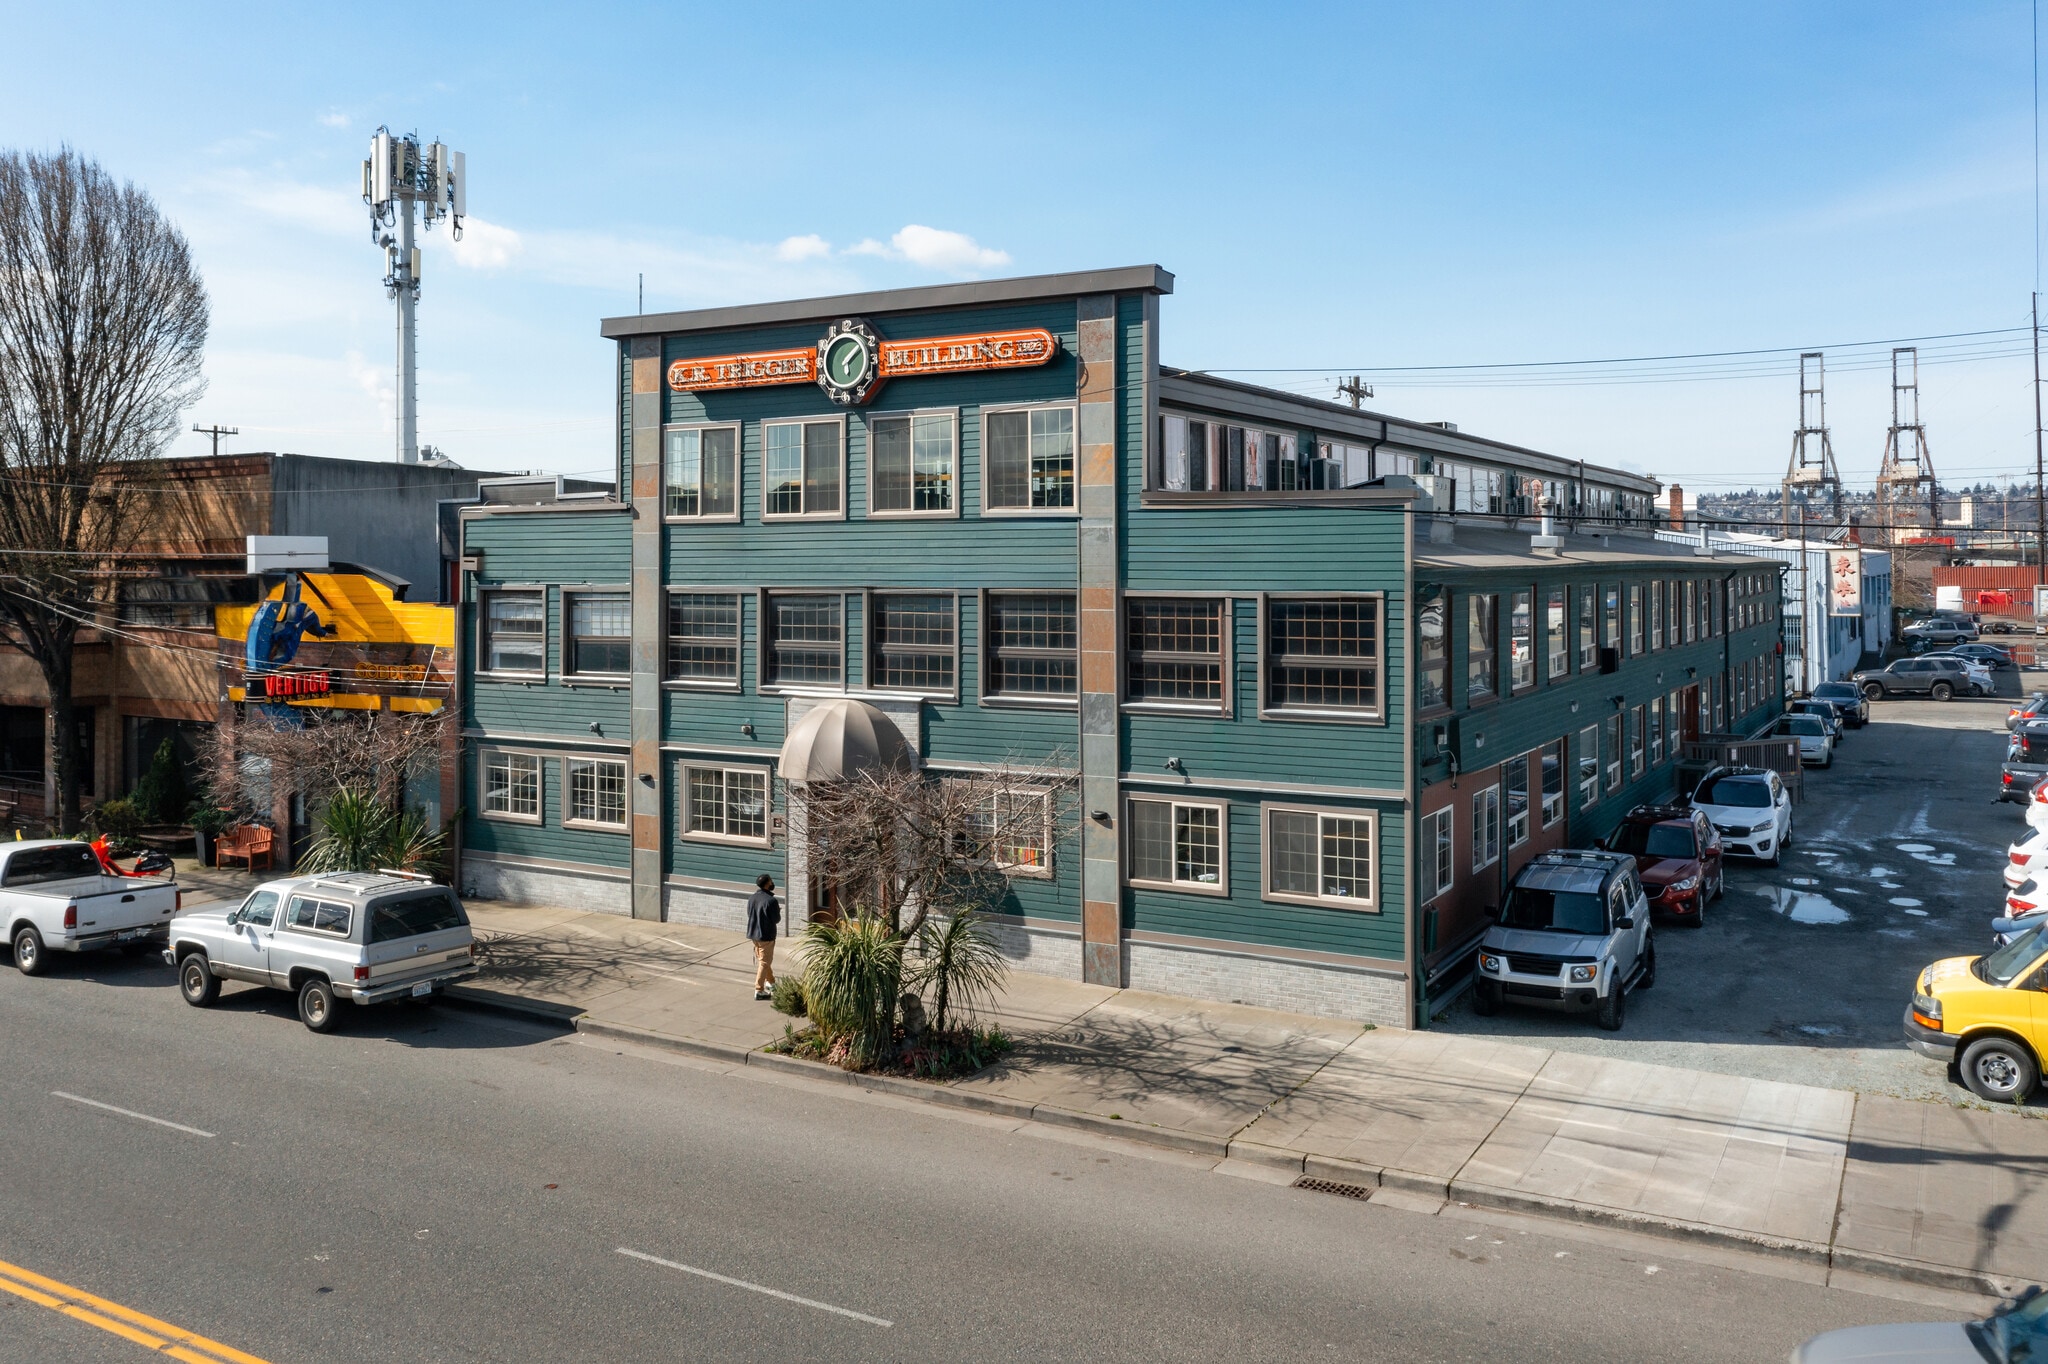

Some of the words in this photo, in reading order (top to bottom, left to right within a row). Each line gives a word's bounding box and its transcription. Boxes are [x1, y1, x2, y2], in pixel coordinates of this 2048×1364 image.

[714, 358, 810, 380] TRIGGER
[886, 340, 1014, 367] BUILDING
[265, 672, 330, 697] VERTIGO
